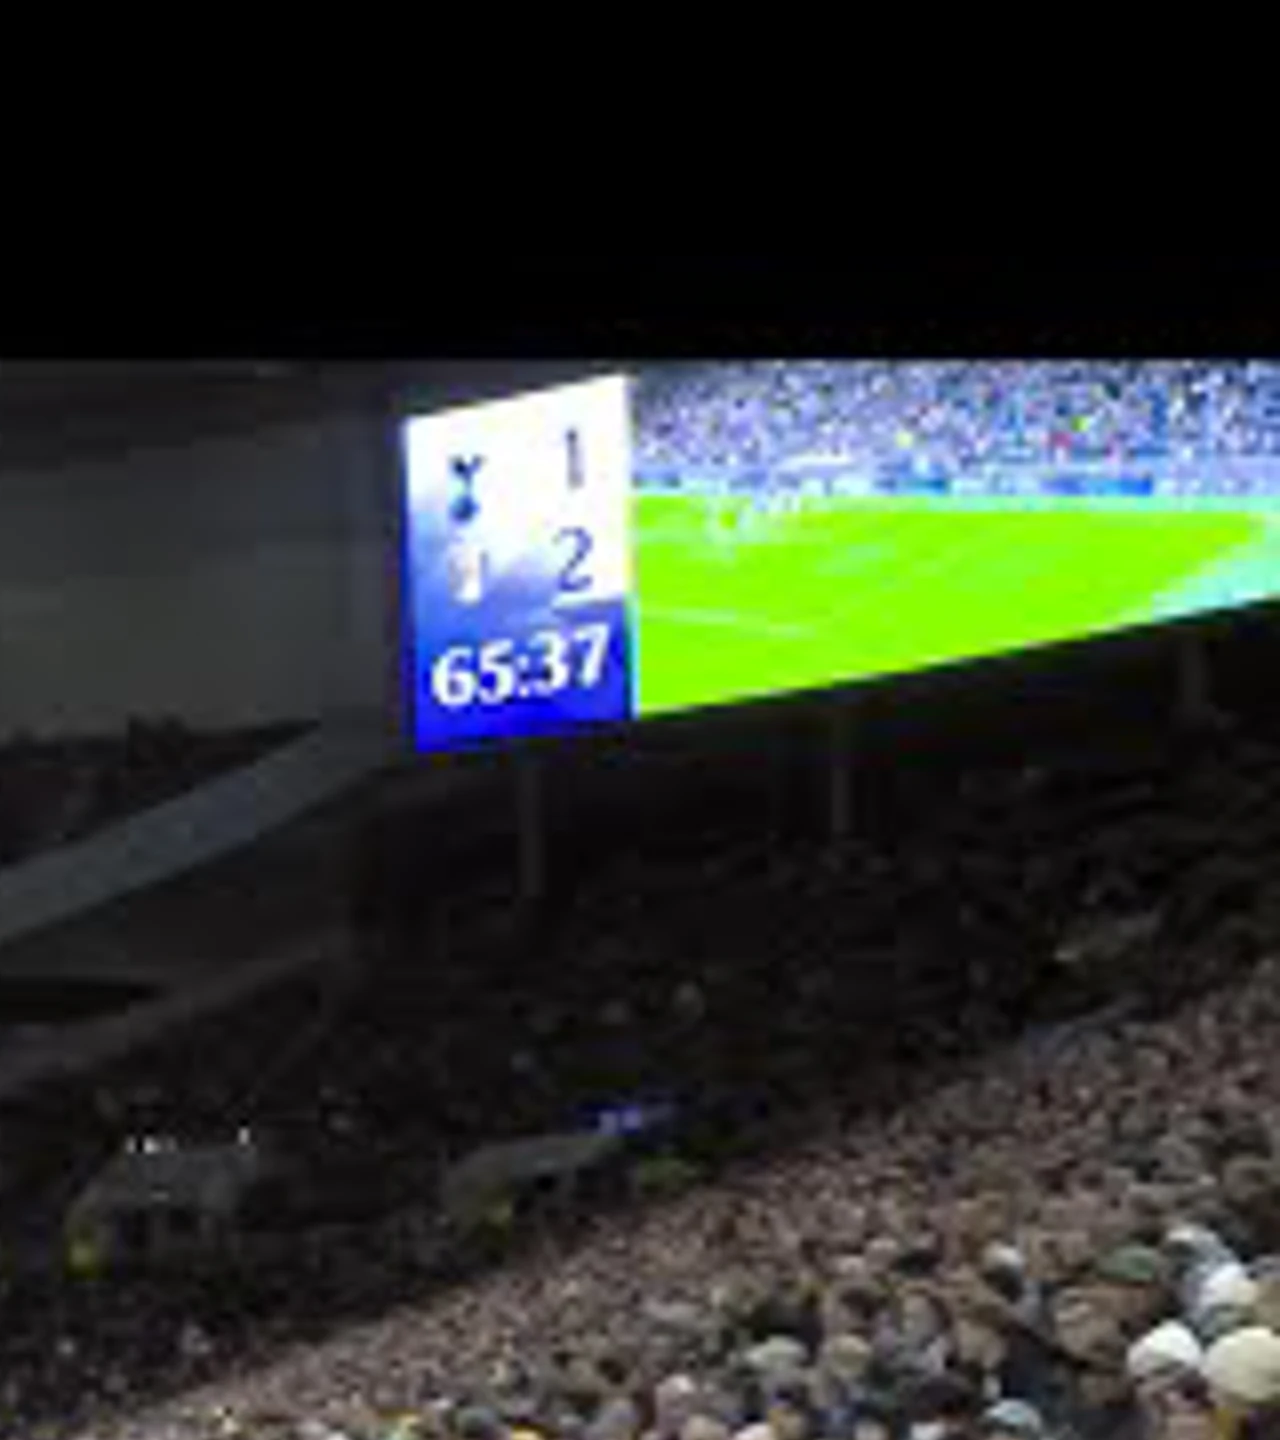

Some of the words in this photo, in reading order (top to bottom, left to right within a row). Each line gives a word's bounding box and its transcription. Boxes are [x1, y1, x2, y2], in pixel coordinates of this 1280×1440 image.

[566, 428, 584, 488] 1
[552, 526, 594, 592] 2
[432, 622, 610, 706] 65:37
